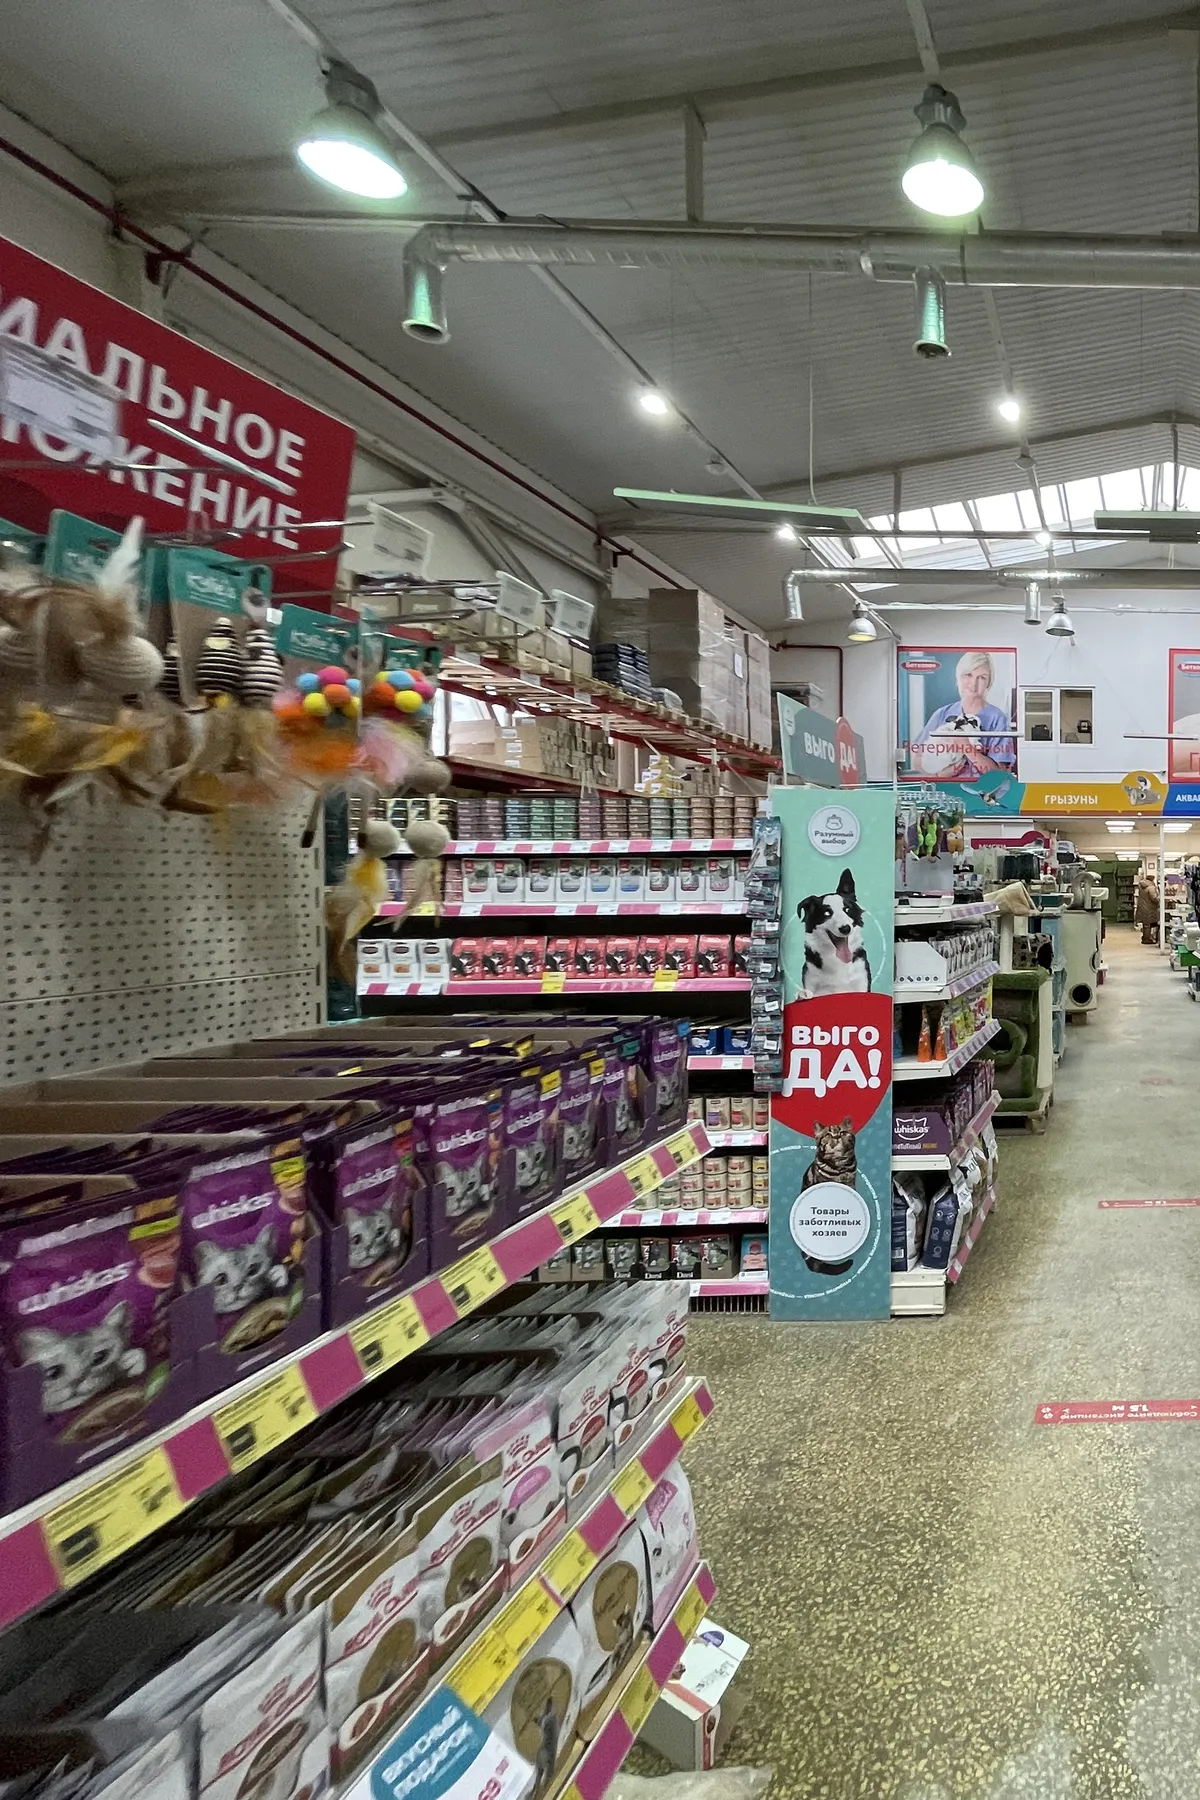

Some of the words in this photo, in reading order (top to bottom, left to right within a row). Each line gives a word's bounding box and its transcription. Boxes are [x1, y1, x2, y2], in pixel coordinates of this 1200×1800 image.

[1, 412, 302, 550] ЖЕНИЕ
[1044, 795, 1098, 805] ГРЫЗУНЫ
[814, 831, 854, 839] Разумный
[822, 838, 847, 846] выбор
[782, 1048, 883, 1097] ДА!
[810, 1207, 850, 1216] Товары
[799, 1218, 862, 1226] заботливых
[811, 1229, 848, 1237] хозяев
[1127, 1411, 1198, 1419] Соблюдайте
